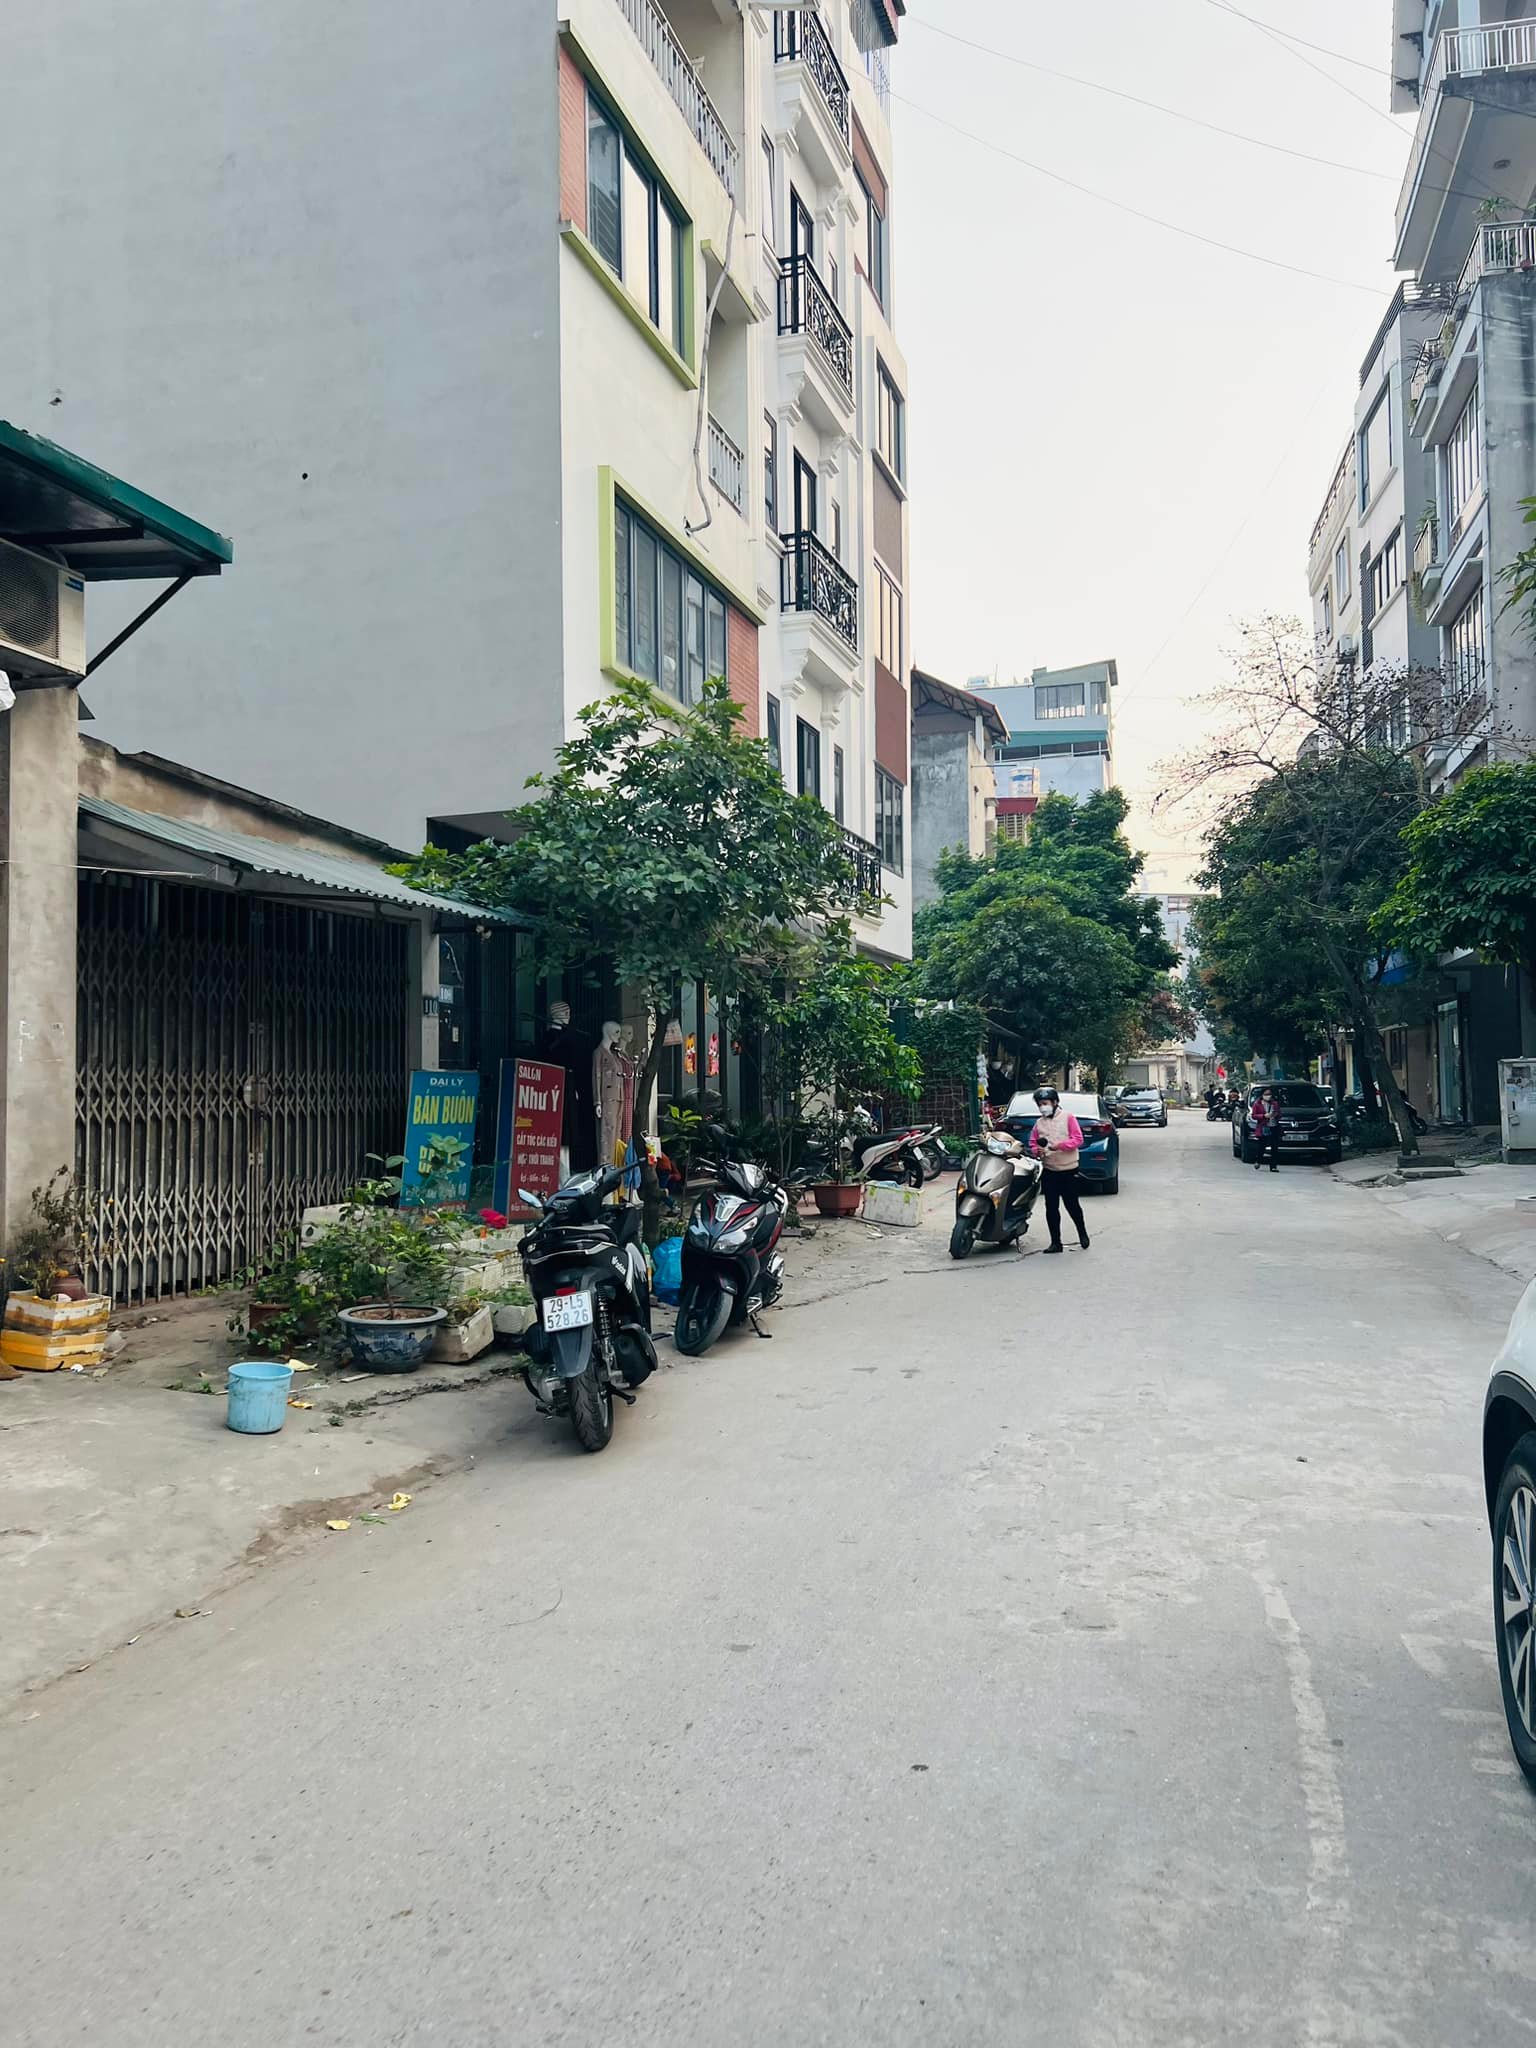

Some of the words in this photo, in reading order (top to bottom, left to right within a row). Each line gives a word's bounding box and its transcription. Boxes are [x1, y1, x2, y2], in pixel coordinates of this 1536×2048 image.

[413, 1088, 440, 1125] BÁN
[442, 1088, 475, 1124] BUÔN
[518, 1085, 548, 1111] Như
[551, 1084, 561, 1113] Ý
[550, 1294, 583, 1313] 29-L5
[547, 1309, 589, 1329] 528.26
